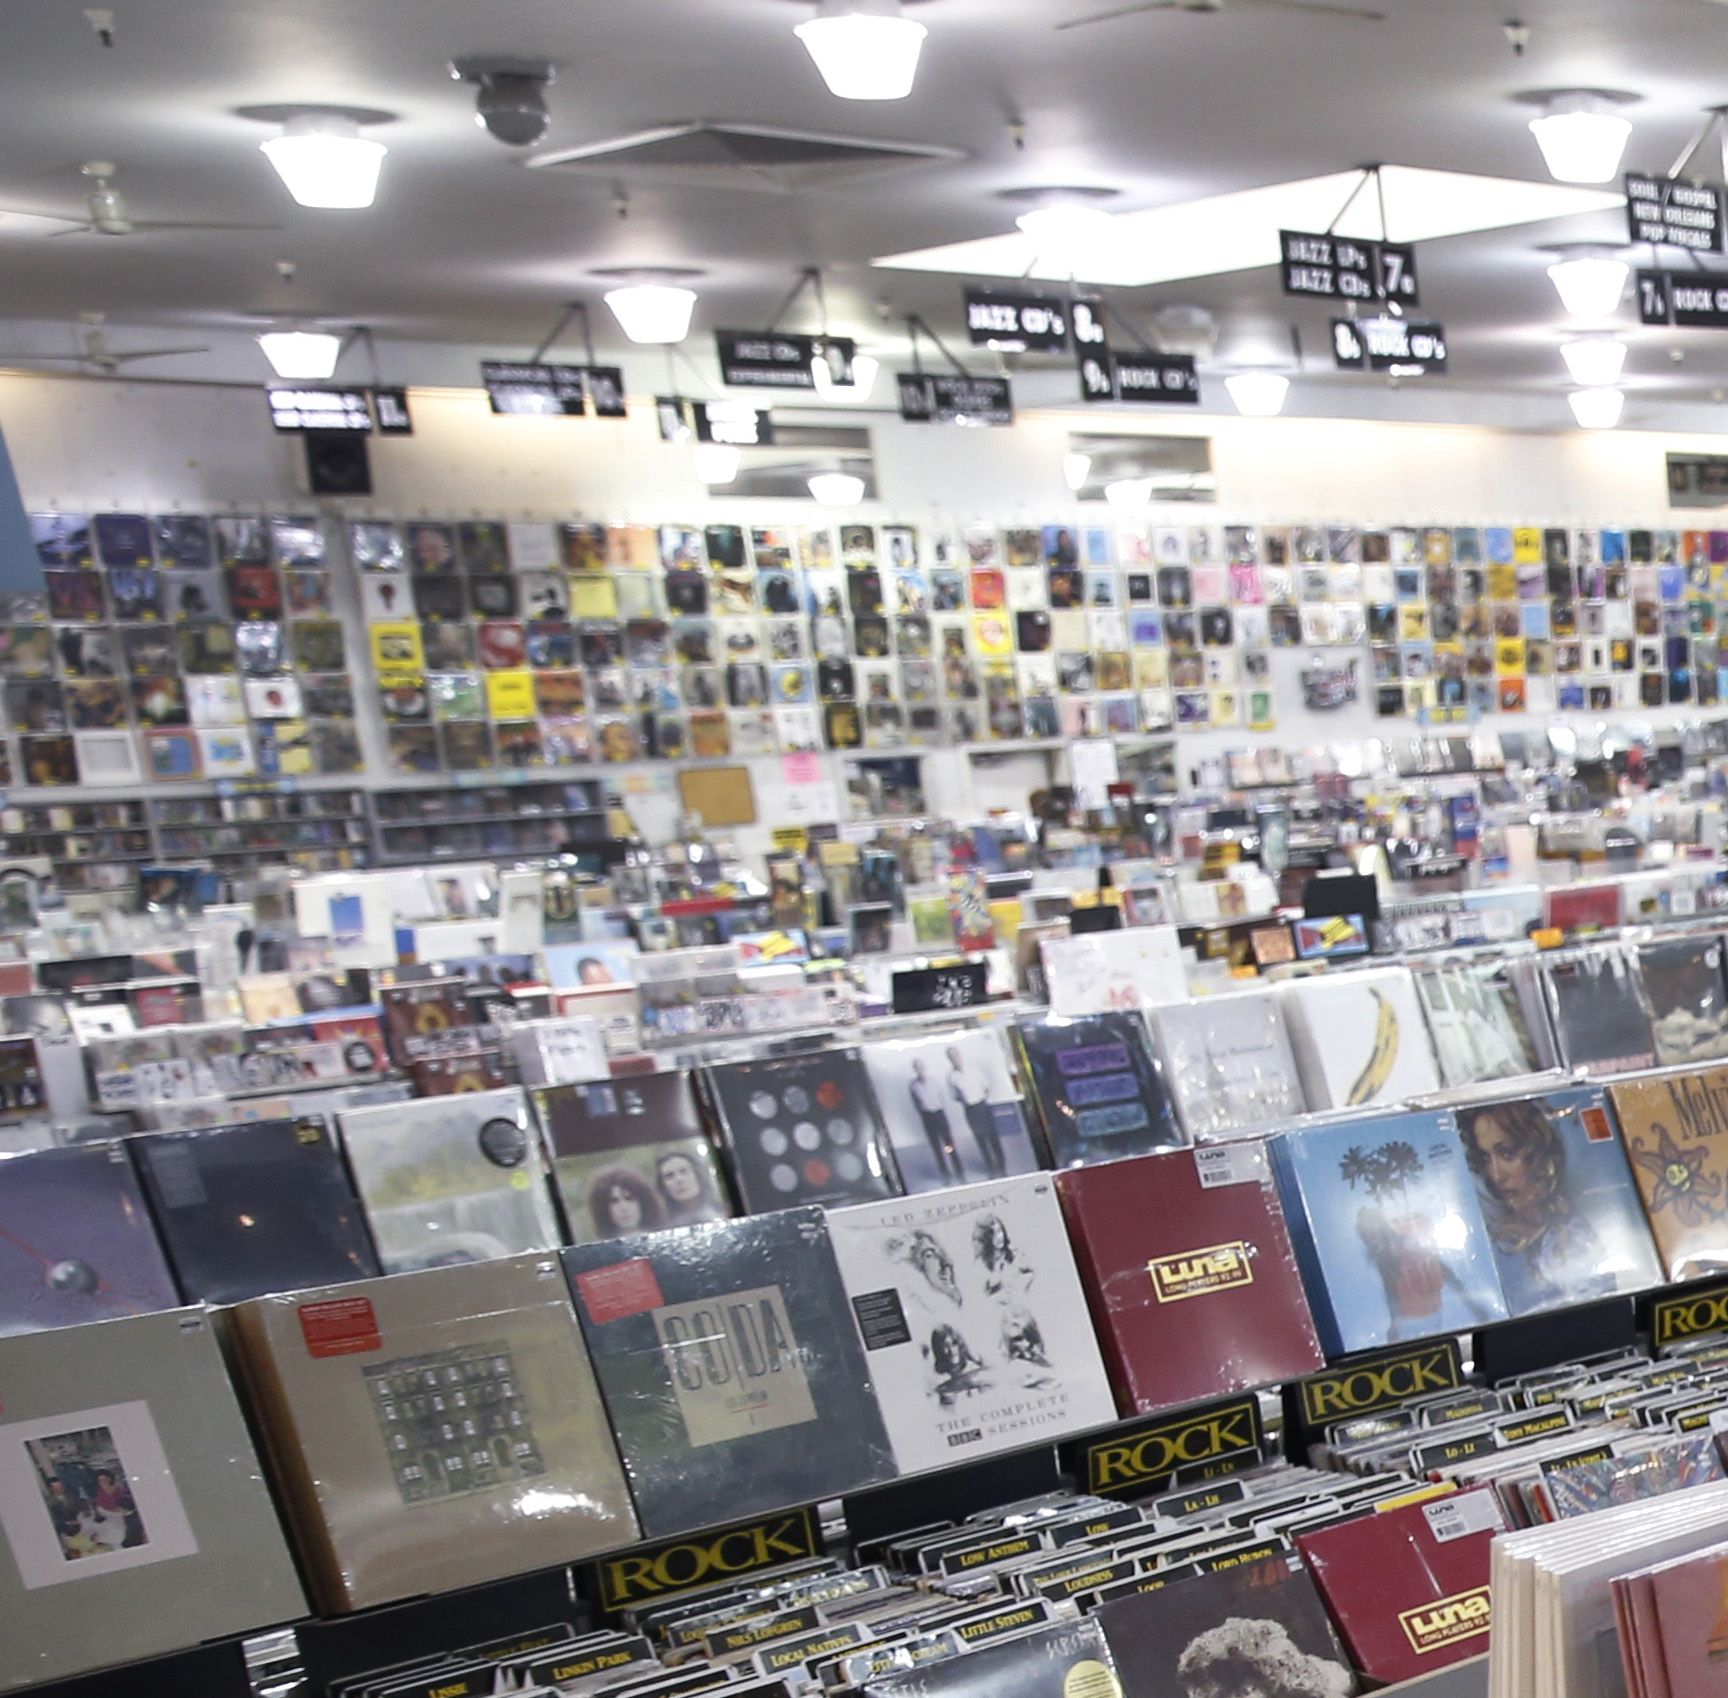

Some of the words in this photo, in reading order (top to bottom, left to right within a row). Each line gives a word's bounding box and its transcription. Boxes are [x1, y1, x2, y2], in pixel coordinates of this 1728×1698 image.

[1633, 204, 1661, 223] NEW
[1664, 206, 1716, 229] ORLEANS
[1638, 224, 1665, 244] POP
[1287, 239, 1334, 267] JAZZ
[1337, 245, 1369, 271] LPs
[1289, 269, 1335, 295] JAZZ
[1674, 287, 1712, 311] ROCK
[968, 303, 1018, 332] JAZZ
[1020, 305, 1066, 336] CD's
[1367, 333, 1408, 358] ROCK
[1409, 333, 1448, 361] CD's
[879, 1212, 915, 1226] LED
[1309, 1356, 1453, 1416] ROCK
[936, 1419, 970, 1435] THE
[979, 1392, 1072, 1424] COMPLETE
[947, 1427, 983, 1447] BBC
[988, 1408, 1068, 1438] SESSIONS
[1096, 1416, 1252, 1485] ROCK
[609, 1518, 806, 1600] ROCK
[960, 1551, 988, 1567] LOW
[988, 1538, 1030, 1560] ANTHEM
[1211, 1557, 1237, 1573] LORD
[1238, 1546, 1273, 1564] HURON
[1064, 1568, 1114, 1593] LOUDNESS
[724, 1633, 754, 1649] NILS
[753, 1617, 804, 1642] LOFGREN
[959, 1618, 997, 1640] LITTLE
[996, 1607, 1035, 1631] STEVEN
[552, 1657, 594, 1682] LINKIN
[596, 1648, 633, 1673] PARK
[770, 1648, 805, 1669] LOCAL
[806, 1634, 855, 1660] NATIVES
